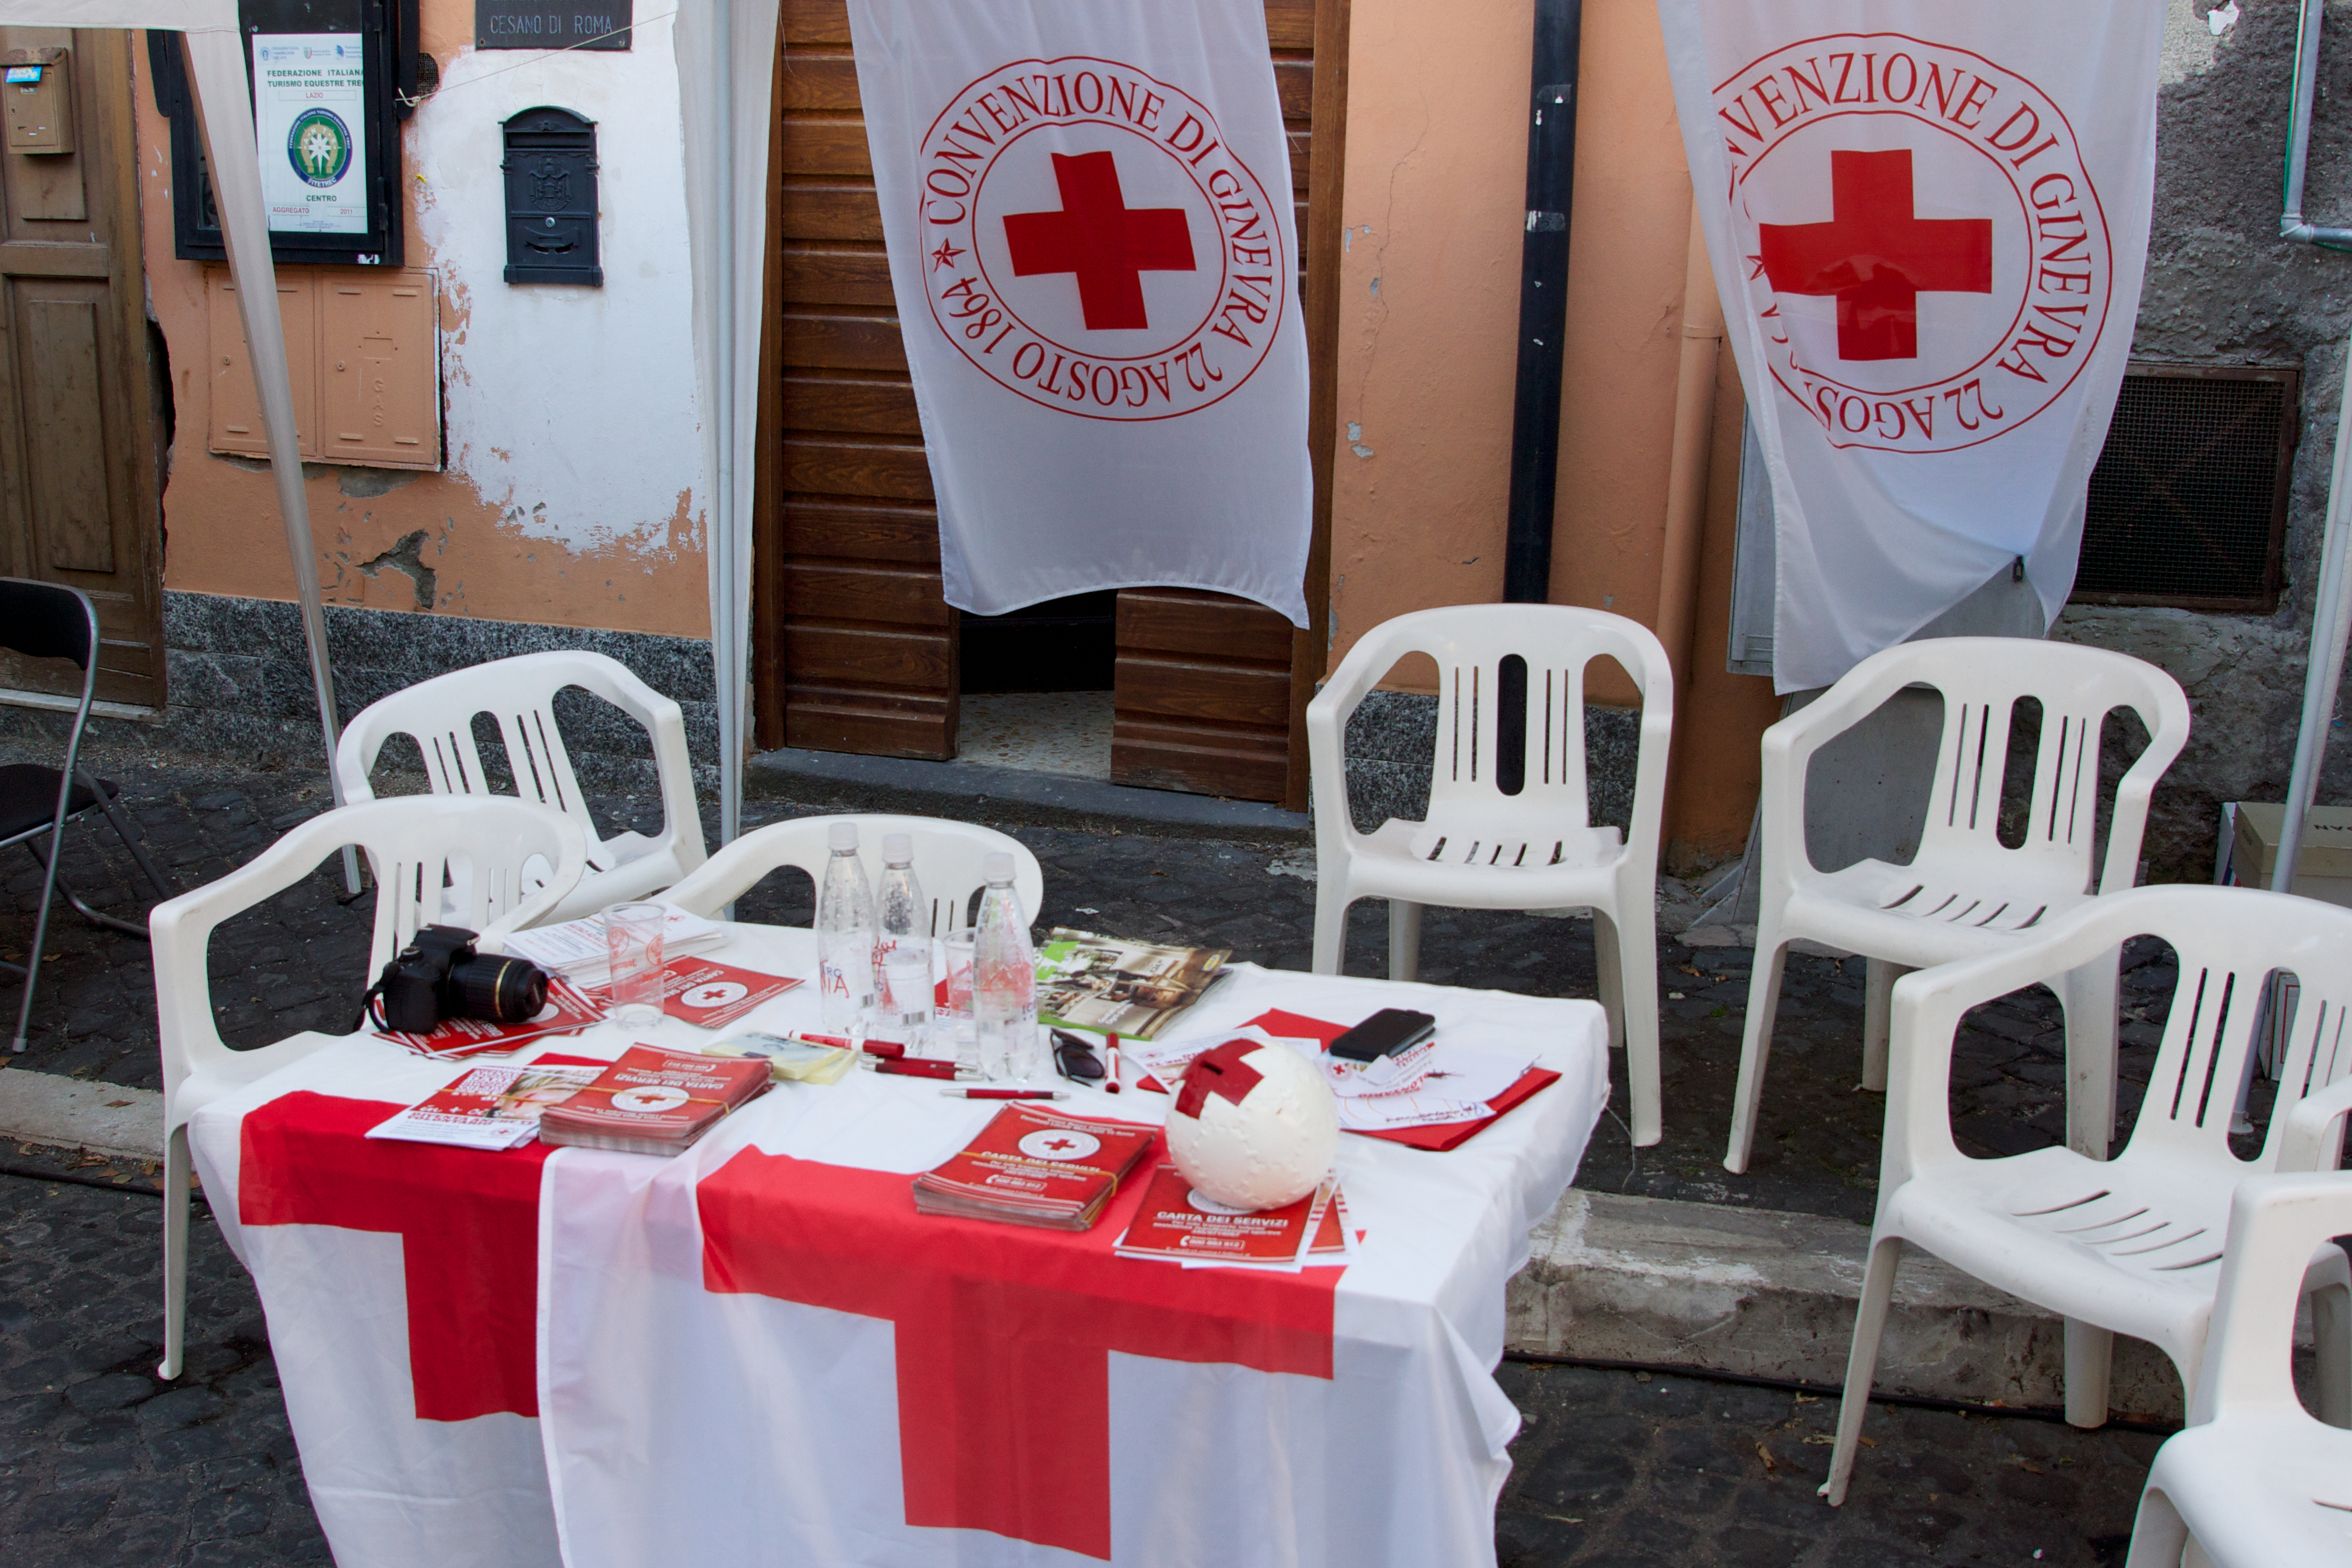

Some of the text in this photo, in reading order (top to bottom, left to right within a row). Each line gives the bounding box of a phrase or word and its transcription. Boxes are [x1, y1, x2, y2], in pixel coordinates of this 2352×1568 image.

[491, 15, 613, 34] CESANO DI ROMA
[1984, 100, 2061, 171] DI
[307, 176, 337, 187] FITETREC
[926, 70, 1273, 349] CONVENZIONE DI GINEVRA
[1995, 173, 2093, 385] GINEVRA
[940, 276, 1224, 408] 22 AGOSTO 1864
[373, 378, 384, 428] GAS
[1943, 378, 2005, 431] 22
[614, 1073, 662, 1085] SERVIZI
[662, 1078, 683, 1087] DEI
[684, 1080, 725, 1090] CARTA
[1156, 1211, 1289, 1227] CARTA DEI SERVIZI
